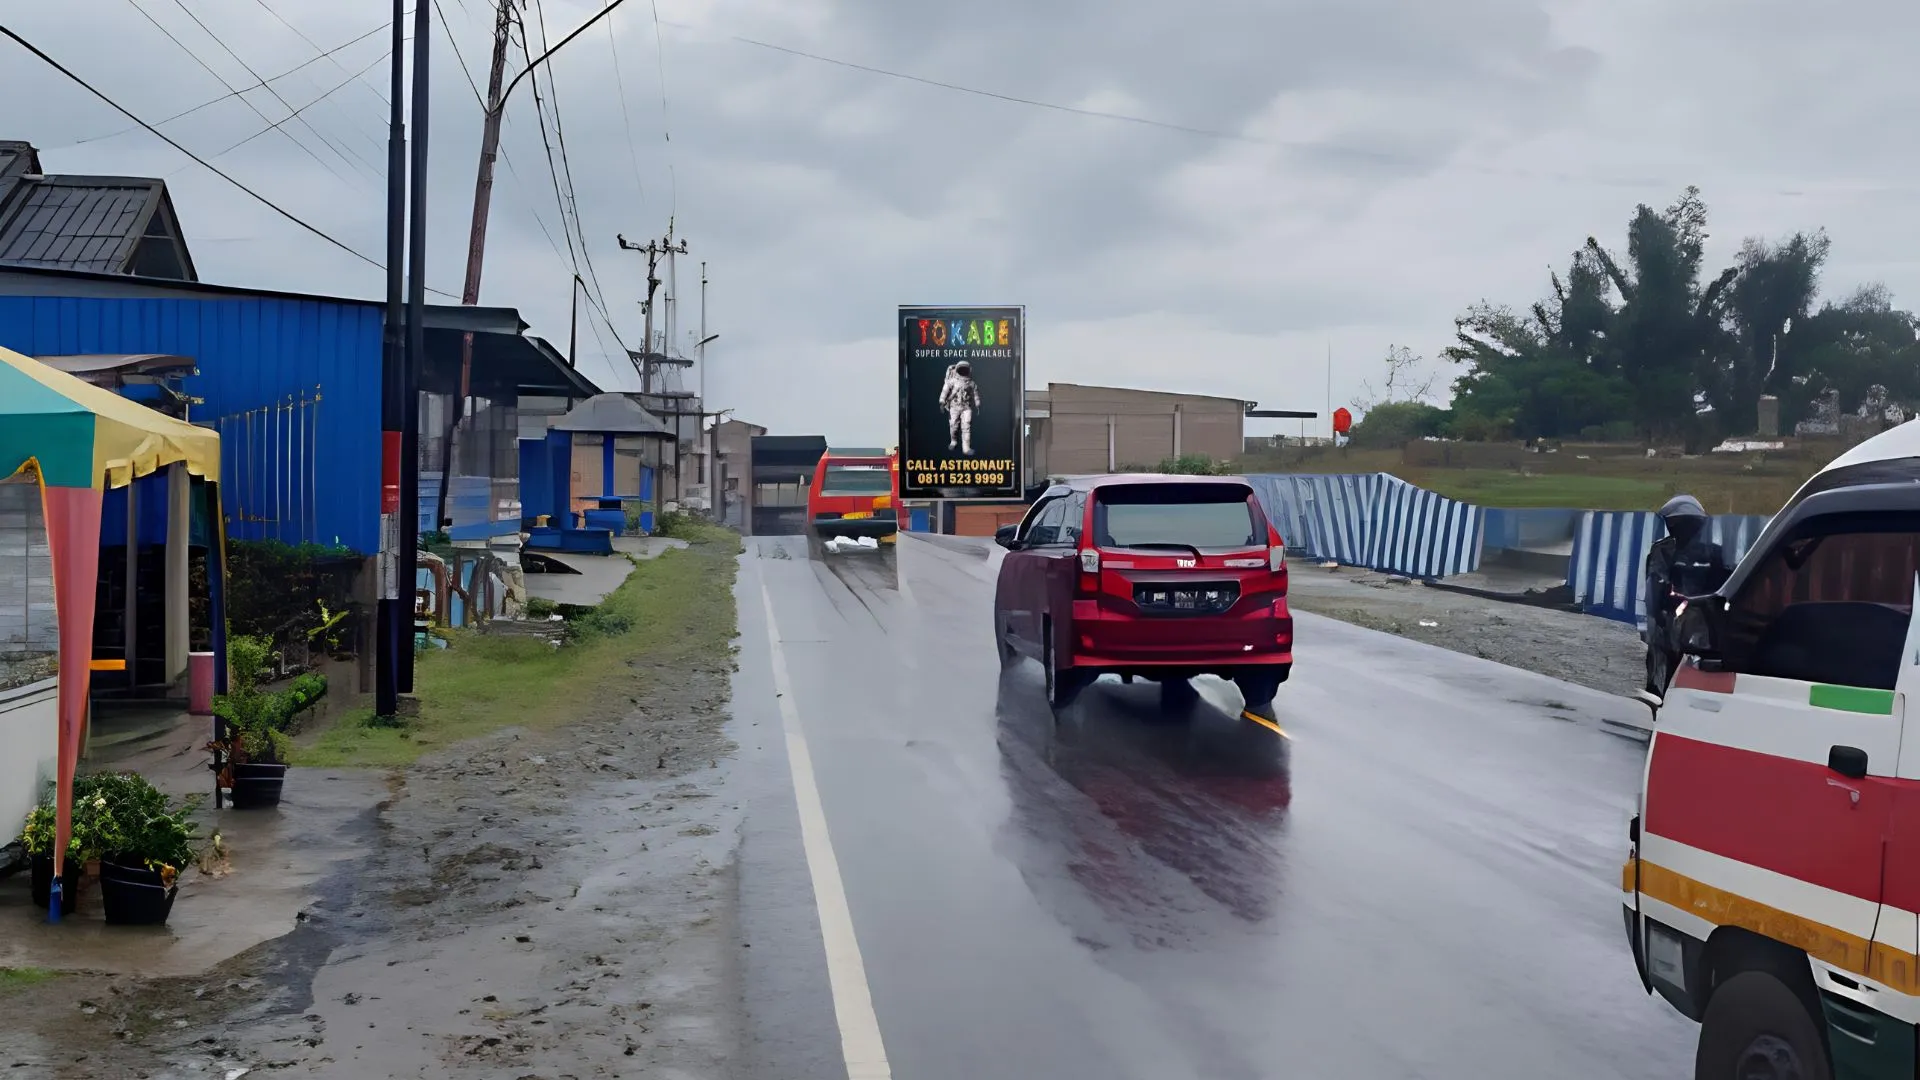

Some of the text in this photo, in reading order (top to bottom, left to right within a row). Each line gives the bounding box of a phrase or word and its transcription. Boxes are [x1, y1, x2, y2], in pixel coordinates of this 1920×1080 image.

[918, 319, 1009, 347] TOKABE
[915, 349, 1012, 358] SUPER SPACE AVAILABLE
[906, 459, 1015, 471] CALL ASTRONAUT:
[917, 472, 1004, 484] 0811 523 9999
